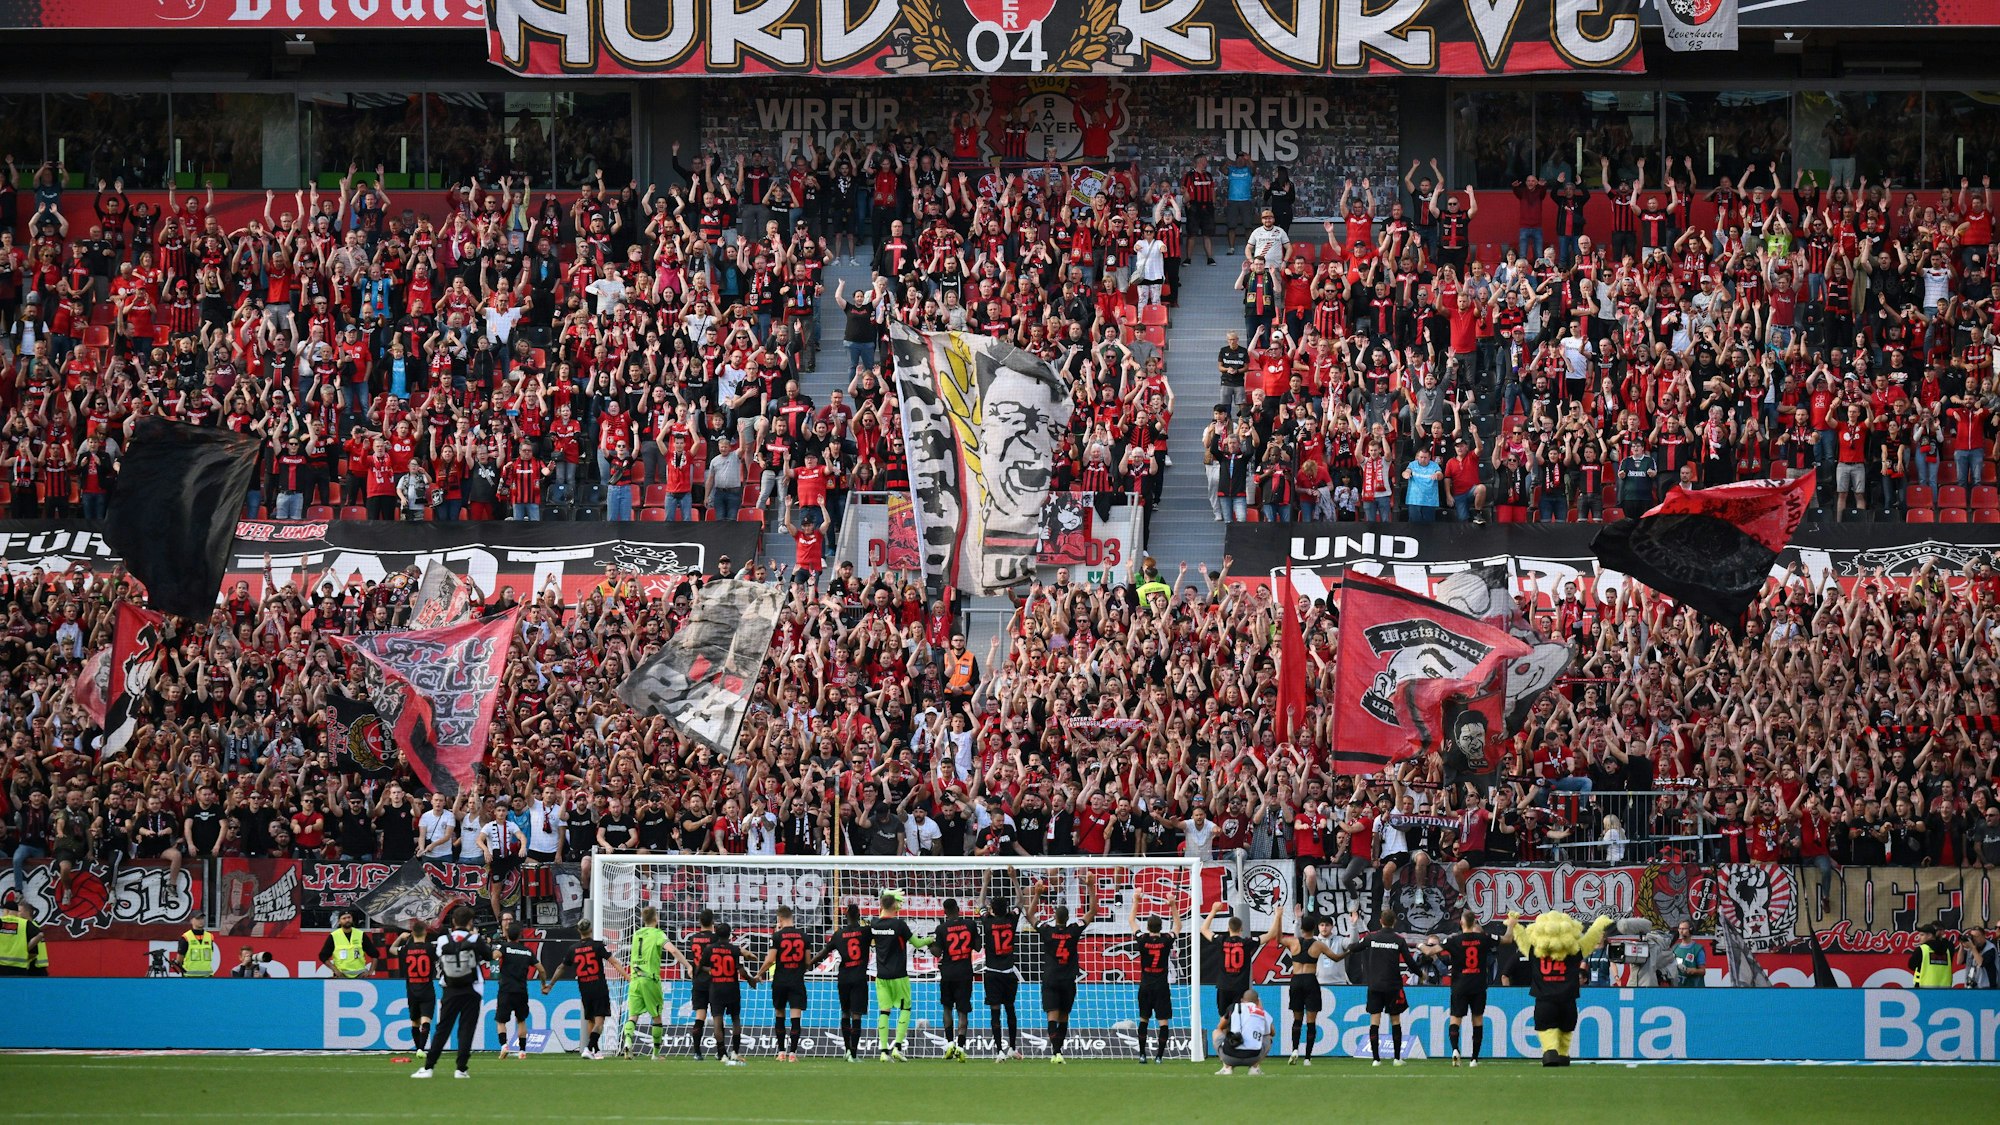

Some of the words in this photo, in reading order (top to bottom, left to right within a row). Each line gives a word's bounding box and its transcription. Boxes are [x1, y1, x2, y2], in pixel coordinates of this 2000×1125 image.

[1667, 28, 1724, 39] Leverkusen
[967, 20, 1048, 71] 04
[1033, 77, 1065, 88] 1904
[755, 98, 825, 130] WIR
[832, 91, 900, 130] FÜR
[1196, 97, 1255, 129] IHR
[1261, 90, 1330, 129] FÜR
[1031, 122, 1080, 133] AYER
[1226, 129, 1299, 162] UNS
[0, 529, 112, 555] FÜR
[275, 523, 328, 539] JUNGS
[869, 538, 887, 566] D
[1086, 538, 1121, 566] D3
[1291, 532, 1419, 560] UND
[1903, 546, 1937, 558] 1904
[253, 865, 299, 905] FREIHEIT
[303, 862, 489, 892] JUGND
[254, 899, 272, 914] FÜR
[272, 892, 292, 911] DIE
[1691, 889, 1717, 901] BAYER
[1699, 880, 1711, 910] BAYER
[253, 905, 297, 923] ULTRAS
[506, 947, 532, 957] Barmenia
[638, 937, 643, 959] 1
[780, 939, 805, 962] 23
[847, 938, 862, 960] 6
[946, 931, 972, 956] 22
[992, 930, 1014, 954] 12
[1055, 940, 1070, 961] 4
[1371, 941, 1399, 950] Barmenia
[406, 955, 431, 977] 20
[573, 952, 600, 977] 25
[710, 955, 735, 977] 30
[1148, 949, 1160, 968] 7
[1223, 947, 1245, 968] 10
[1465, 946, 1479, 969] 8
[1540, 957, 1567, 975] 04
